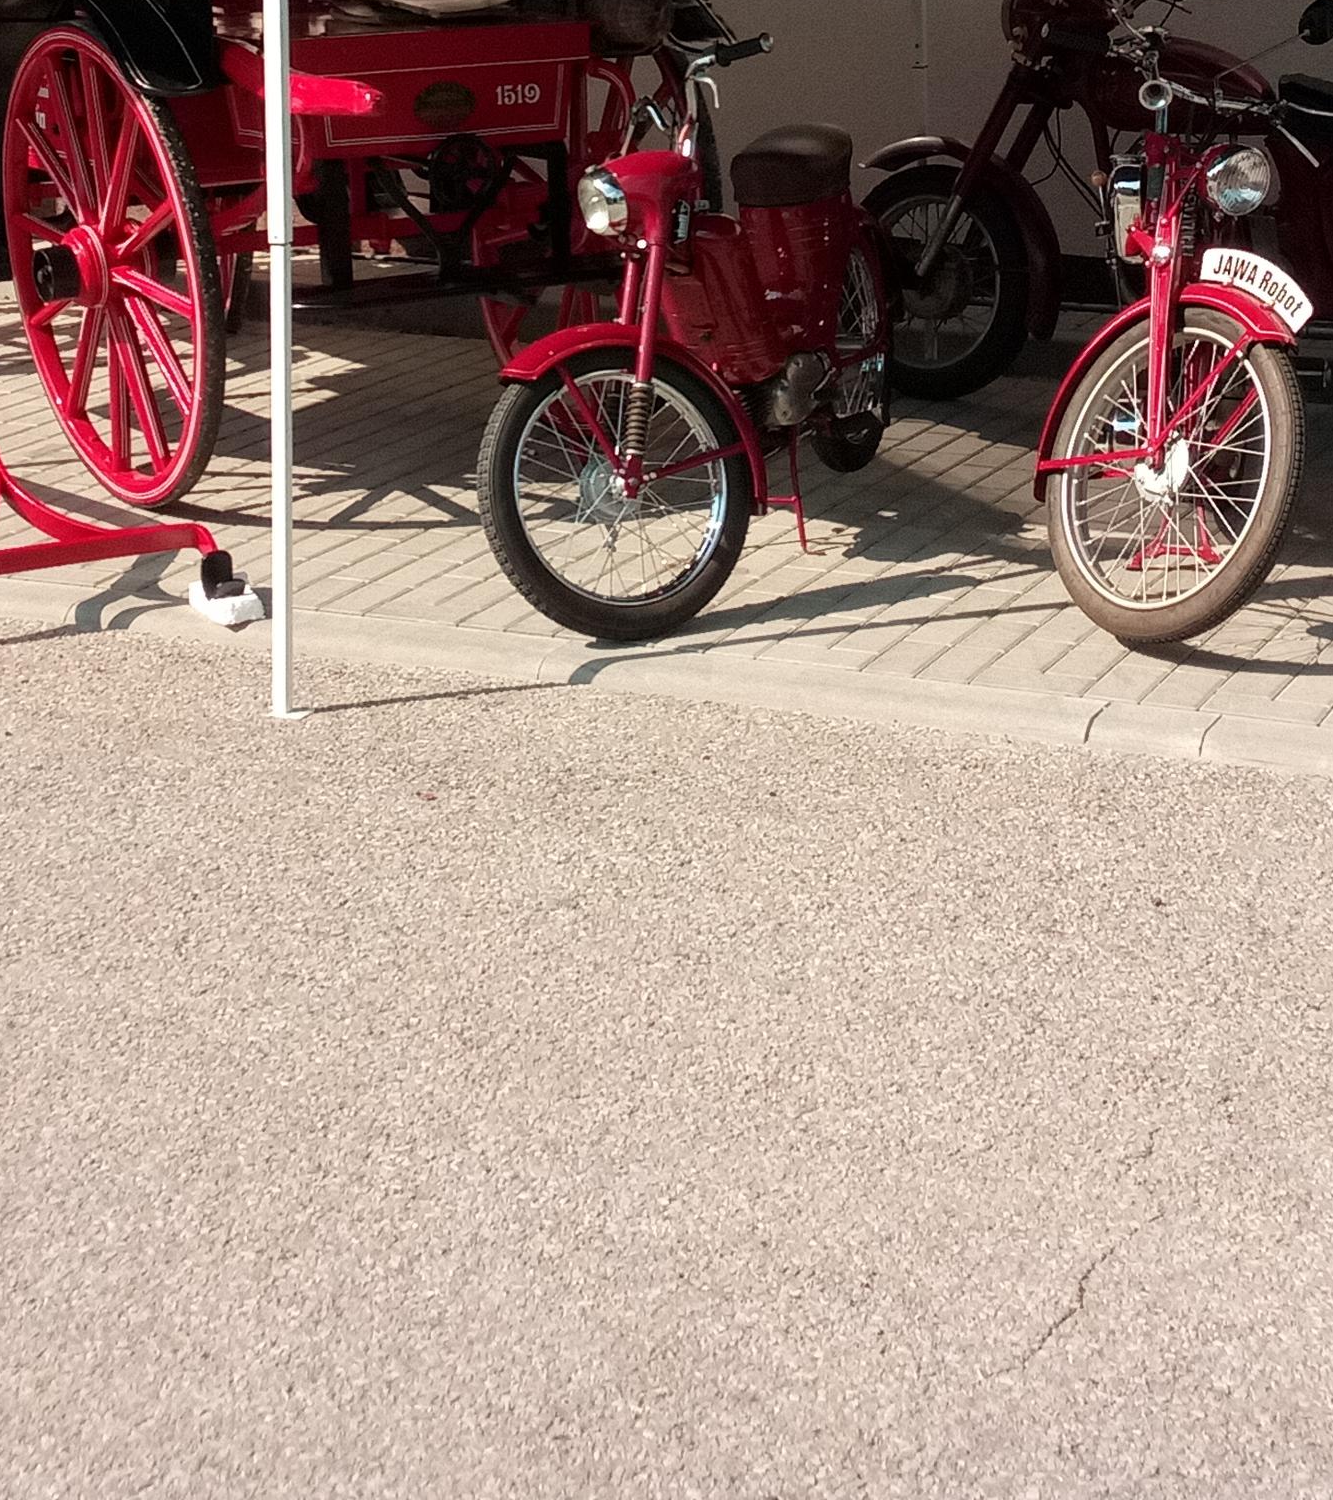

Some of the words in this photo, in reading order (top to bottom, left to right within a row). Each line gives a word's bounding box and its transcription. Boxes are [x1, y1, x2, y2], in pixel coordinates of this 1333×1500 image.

[495, 83, 541, 106] 1519
[1213, 254, 1259, 286] JAWA
[1258, 270, 1304, 318] Robot
